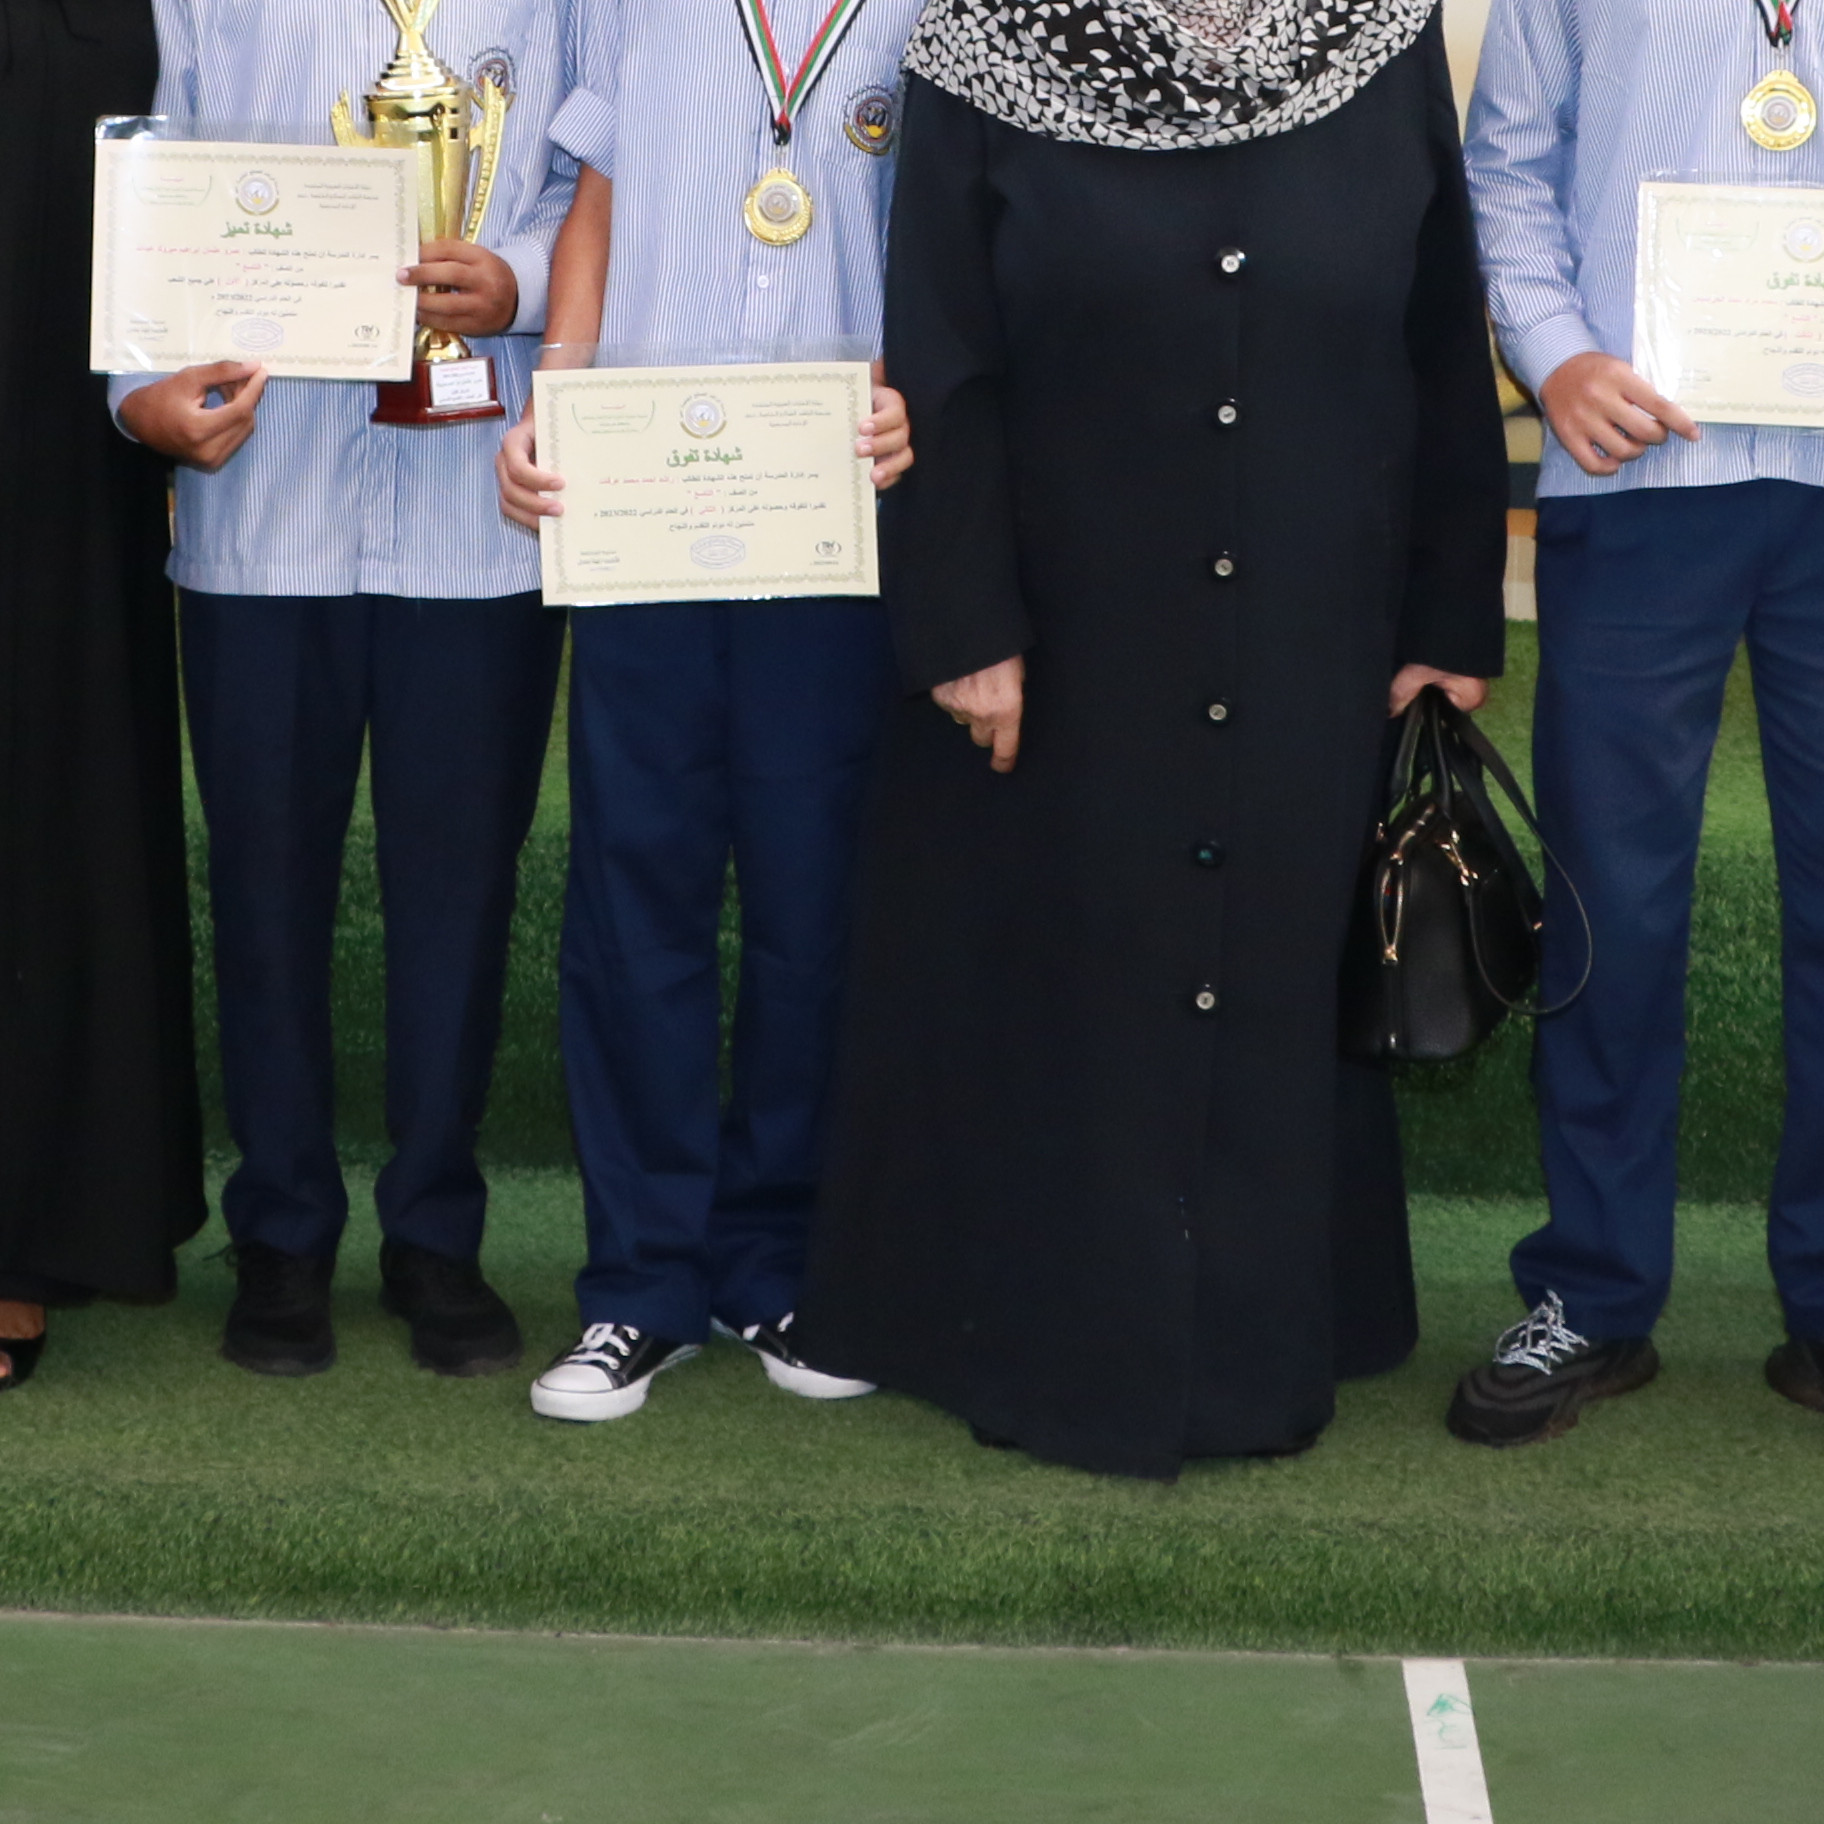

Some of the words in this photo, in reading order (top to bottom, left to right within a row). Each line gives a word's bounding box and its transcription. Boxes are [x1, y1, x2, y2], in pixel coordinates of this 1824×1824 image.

[219, 221, 250, 239] تميز
[253, 220, 294, 239] شهادة
[666, 448, 701, 468] تفوق
[703, 445, 744, 465] شهادة
